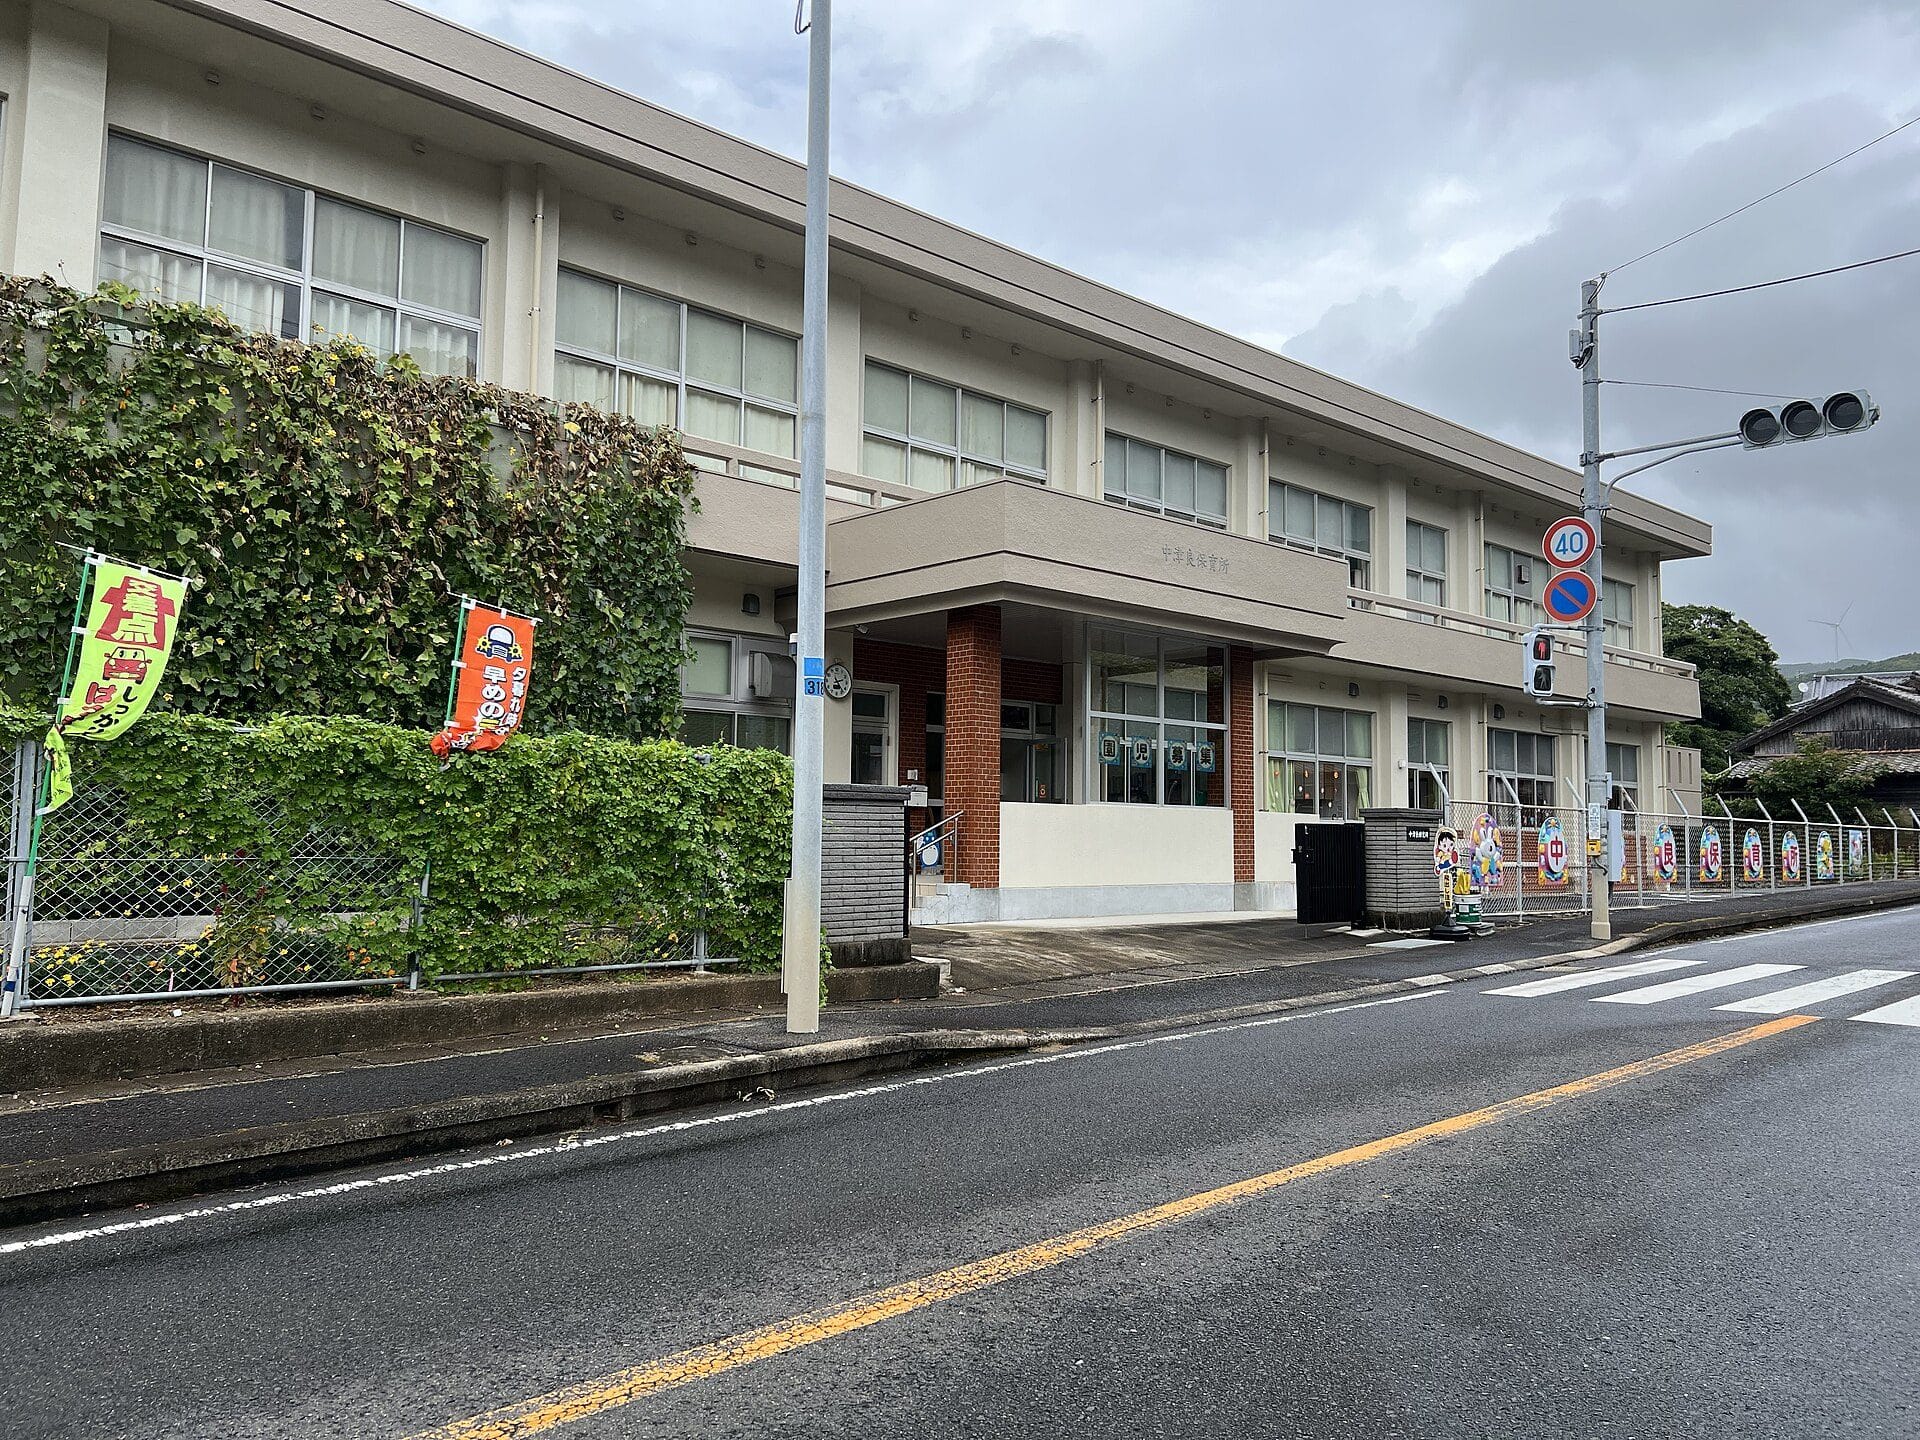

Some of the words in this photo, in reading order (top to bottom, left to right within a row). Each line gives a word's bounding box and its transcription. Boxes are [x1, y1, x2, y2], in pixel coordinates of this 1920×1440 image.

[1556, 532, 1583, 554] 40
[110, 578, 158, 644] 交差点
